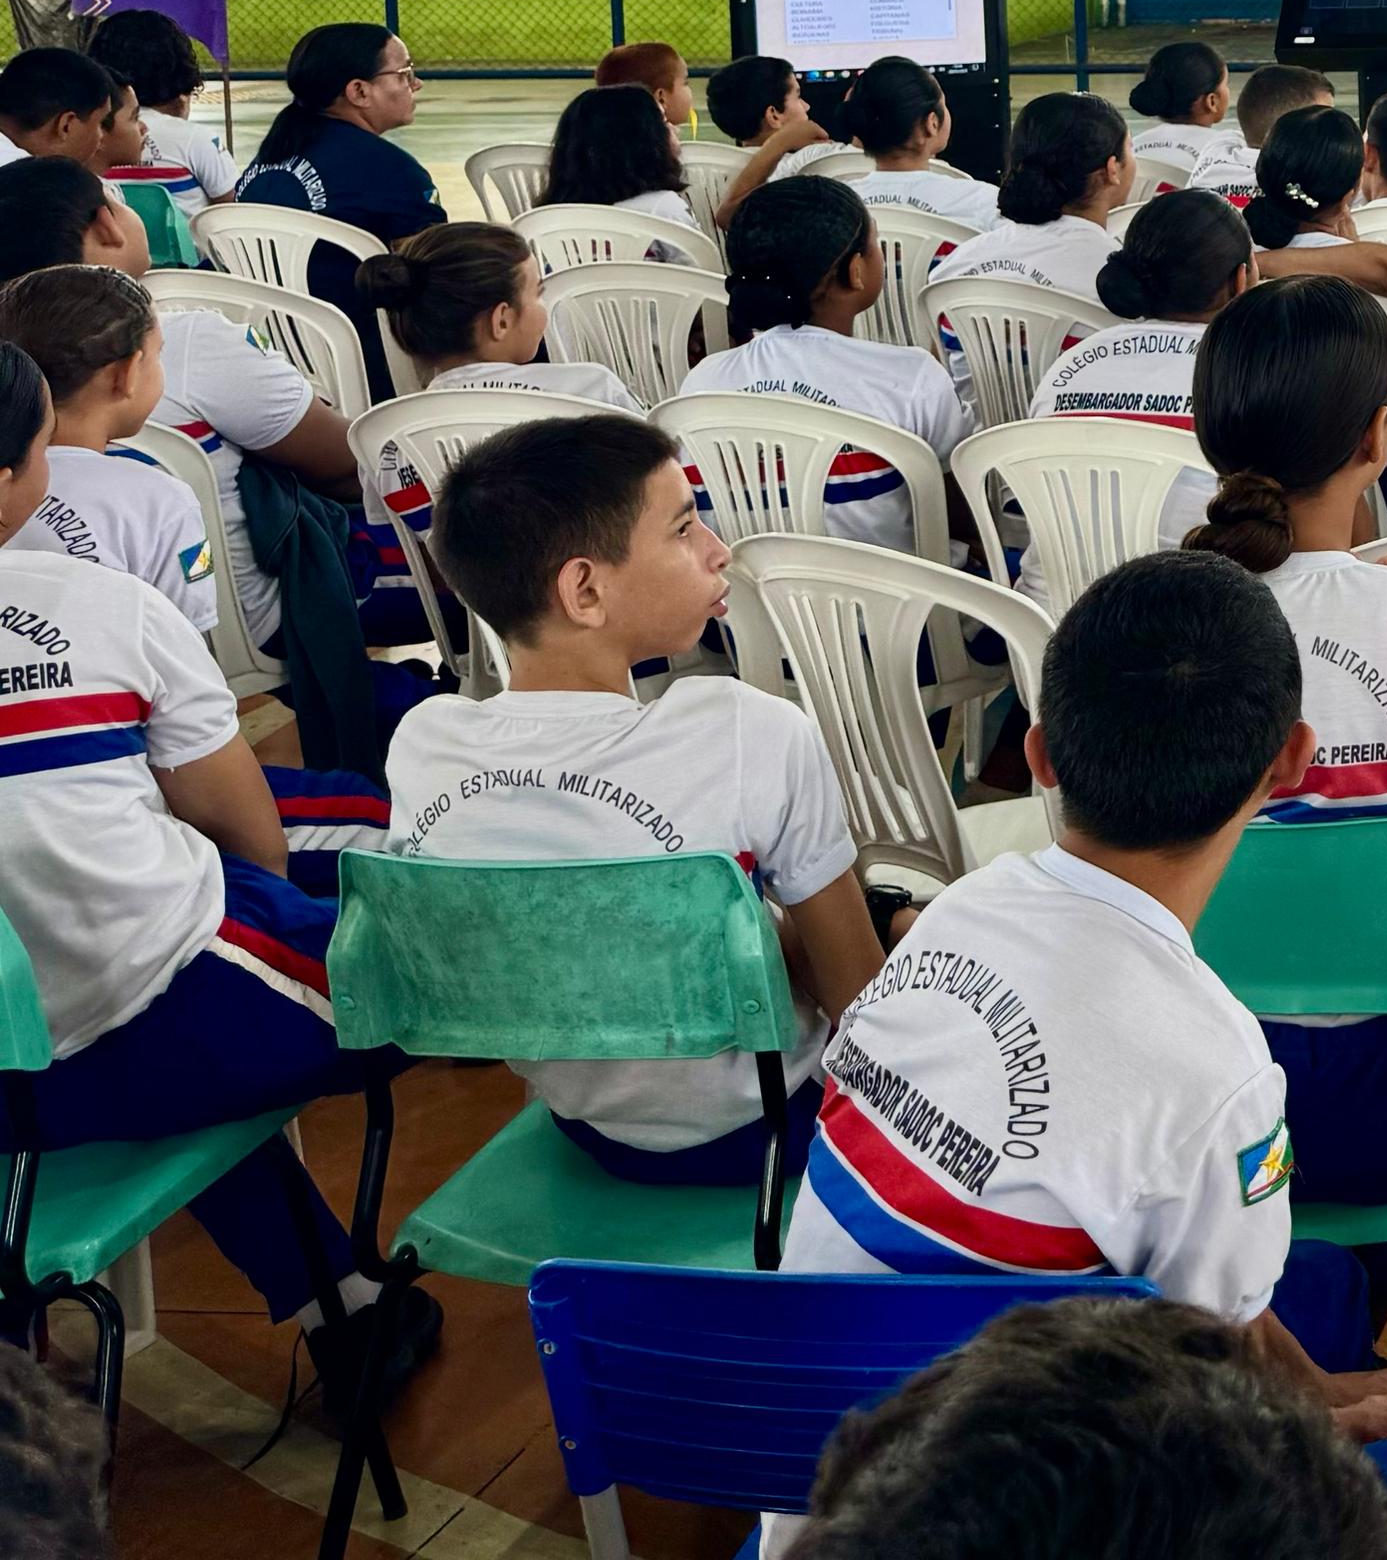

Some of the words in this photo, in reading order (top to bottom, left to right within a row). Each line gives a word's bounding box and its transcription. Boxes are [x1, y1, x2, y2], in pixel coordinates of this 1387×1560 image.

[981, 258, 1027, 276] ESTADUAL
[1052, 345, 1108, 388] COLÉGIO
[1113, 335, 1184, 355] ESTADUAL
[1054, 392, 1142, 412] DESEMBARGADOR
[1143, 394, 1182, 414] SADOC
[0, 661, 73, 696] EREIRA
[557, 771, 684, 853] MILITARIZADO
[912, 951, 1003, 1015] ESTADUAL
[982, 989, 1050, 1160] MILITARIZADO
[894, 1089, 944, 1152] SADOC
[929, 1118, 1001, 1197] PEREIRA
